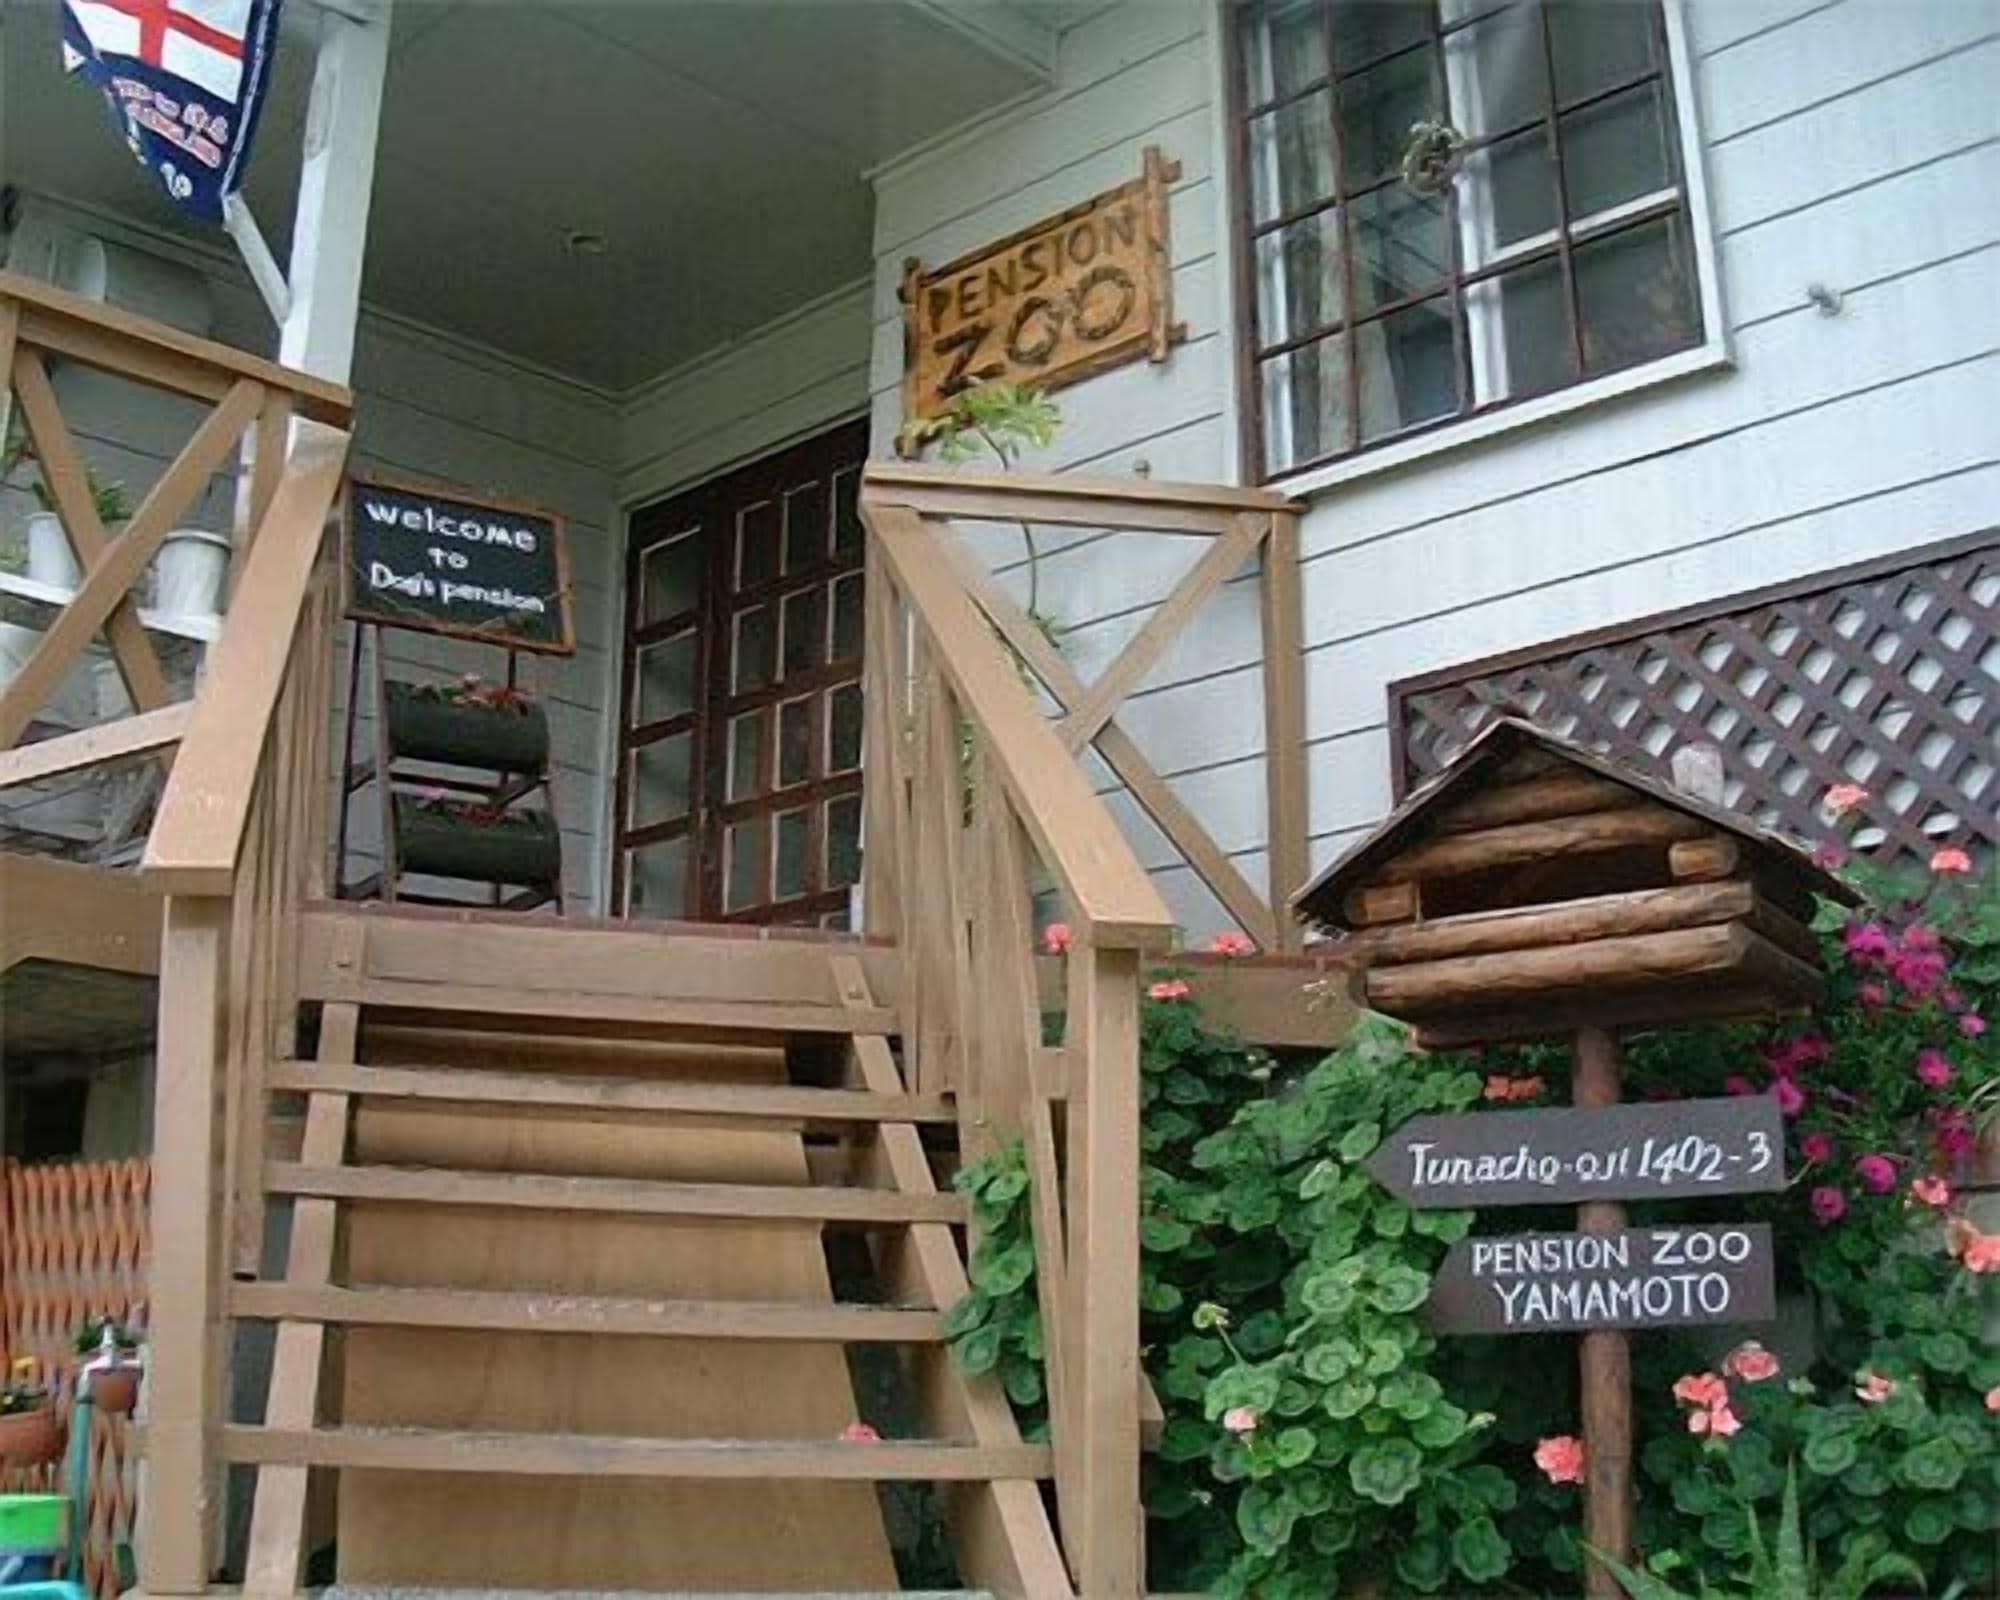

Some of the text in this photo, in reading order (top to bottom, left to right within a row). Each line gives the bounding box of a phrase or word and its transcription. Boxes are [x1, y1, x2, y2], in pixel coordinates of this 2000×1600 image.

[928, 203, 1137, 333] PENSION
[933, 264, 1136, 399] ZOO
[1637, 1130, 1773, 1184] 1402-3
[1472, 1230, 1752, 1276] PENSION ZOO
[1492, 1271, 1732, 1325] YAMAMOTO
